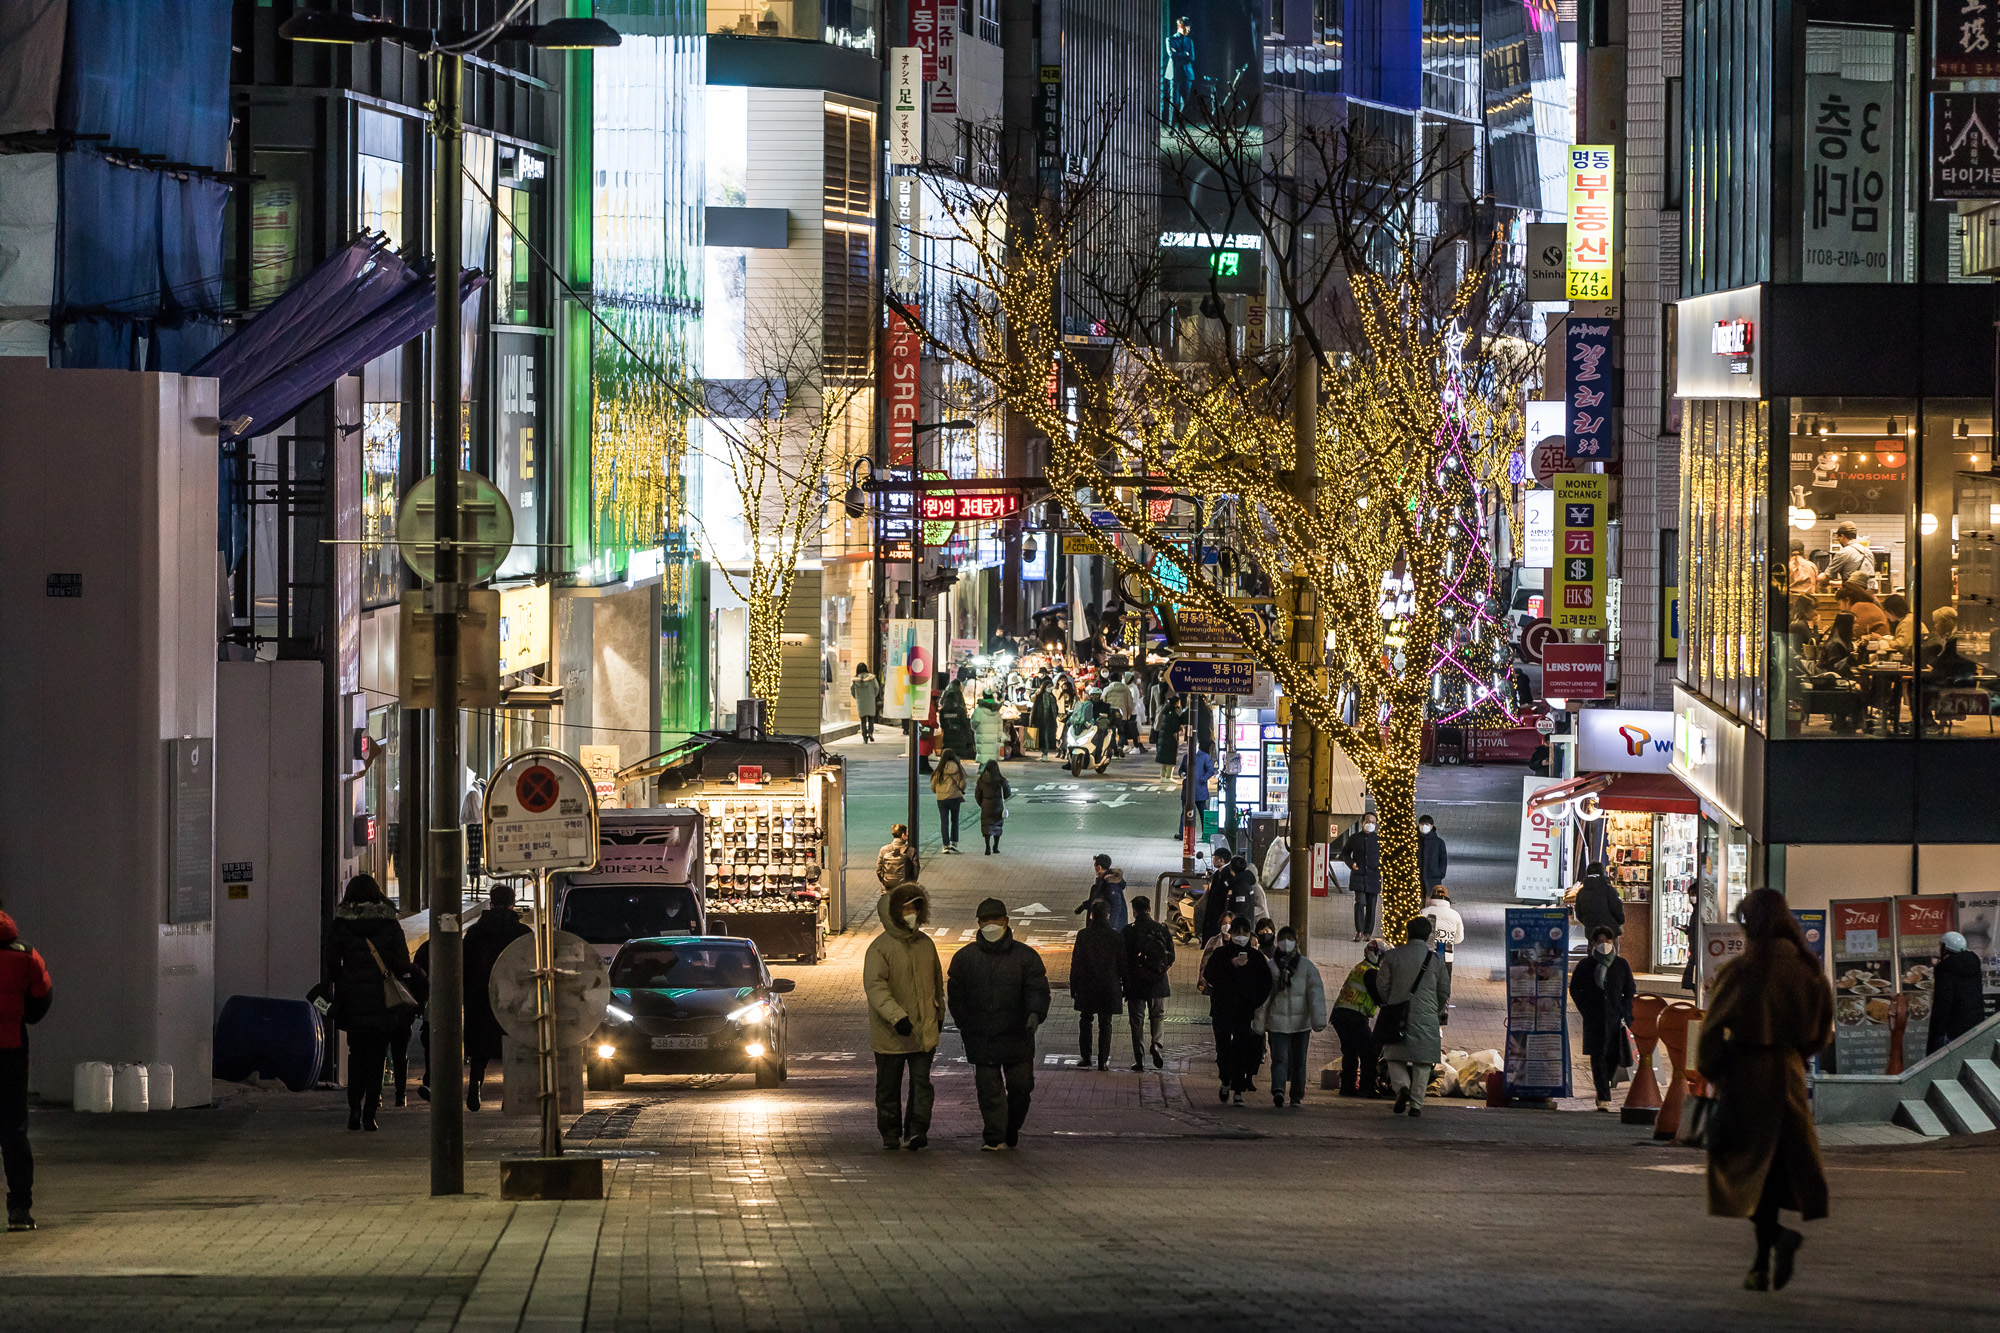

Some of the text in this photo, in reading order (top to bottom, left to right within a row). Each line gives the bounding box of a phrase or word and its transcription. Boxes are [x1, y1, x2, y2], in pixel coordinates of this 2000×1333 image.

[912, 0, 935, 58] 동산
[935, 26, 954, 97] 쥬비스
[1042, 69, 1060, 80] 치과
[898, 88, 912, 104] 足
[1572, 150, 1610, 170] 명동
[1574, 173, 1610, 264] 부동산
[1569, 271, 1607, 284] 774-
[1569, 284, 1609, 297] 5454
[1604, 306, 1618, 316] 2F
[893, 321, 915, 357] the
[1572, 342, 1606, 435] 갤러리
[1530, 420, 1540, 435] 4
[1838, 471, 1897, 481] TWOSOME
[1565, 479, 1598, 489] MONEY
[1557, 490, 1603, 499] EXCHANGE
[959, 497, 1005, 517] 과태료가
[1530, 508, 1540, 525] 2
[1568, 533, 1590, 552] 元
[1570, 559, 1587, 580] $
[1565, 587, 1593, 606] HK$
[1179, 612, 1214, 624] 명동9길
[1559, 614, 1597, 625] 고래환전
[1212, 663, 1252, 675] 명동10길
[1546, 662, 1602, 672] LENS TOWN
[1184, 675, 1252, 685] Myeongdong 10-gil
[596, 784, 613, 792] ,000
[1527, 812, 1555, 869] 약국
[1850, 911, 1881, 925] Thai
[1914, 907, 1945, 921] Thai
